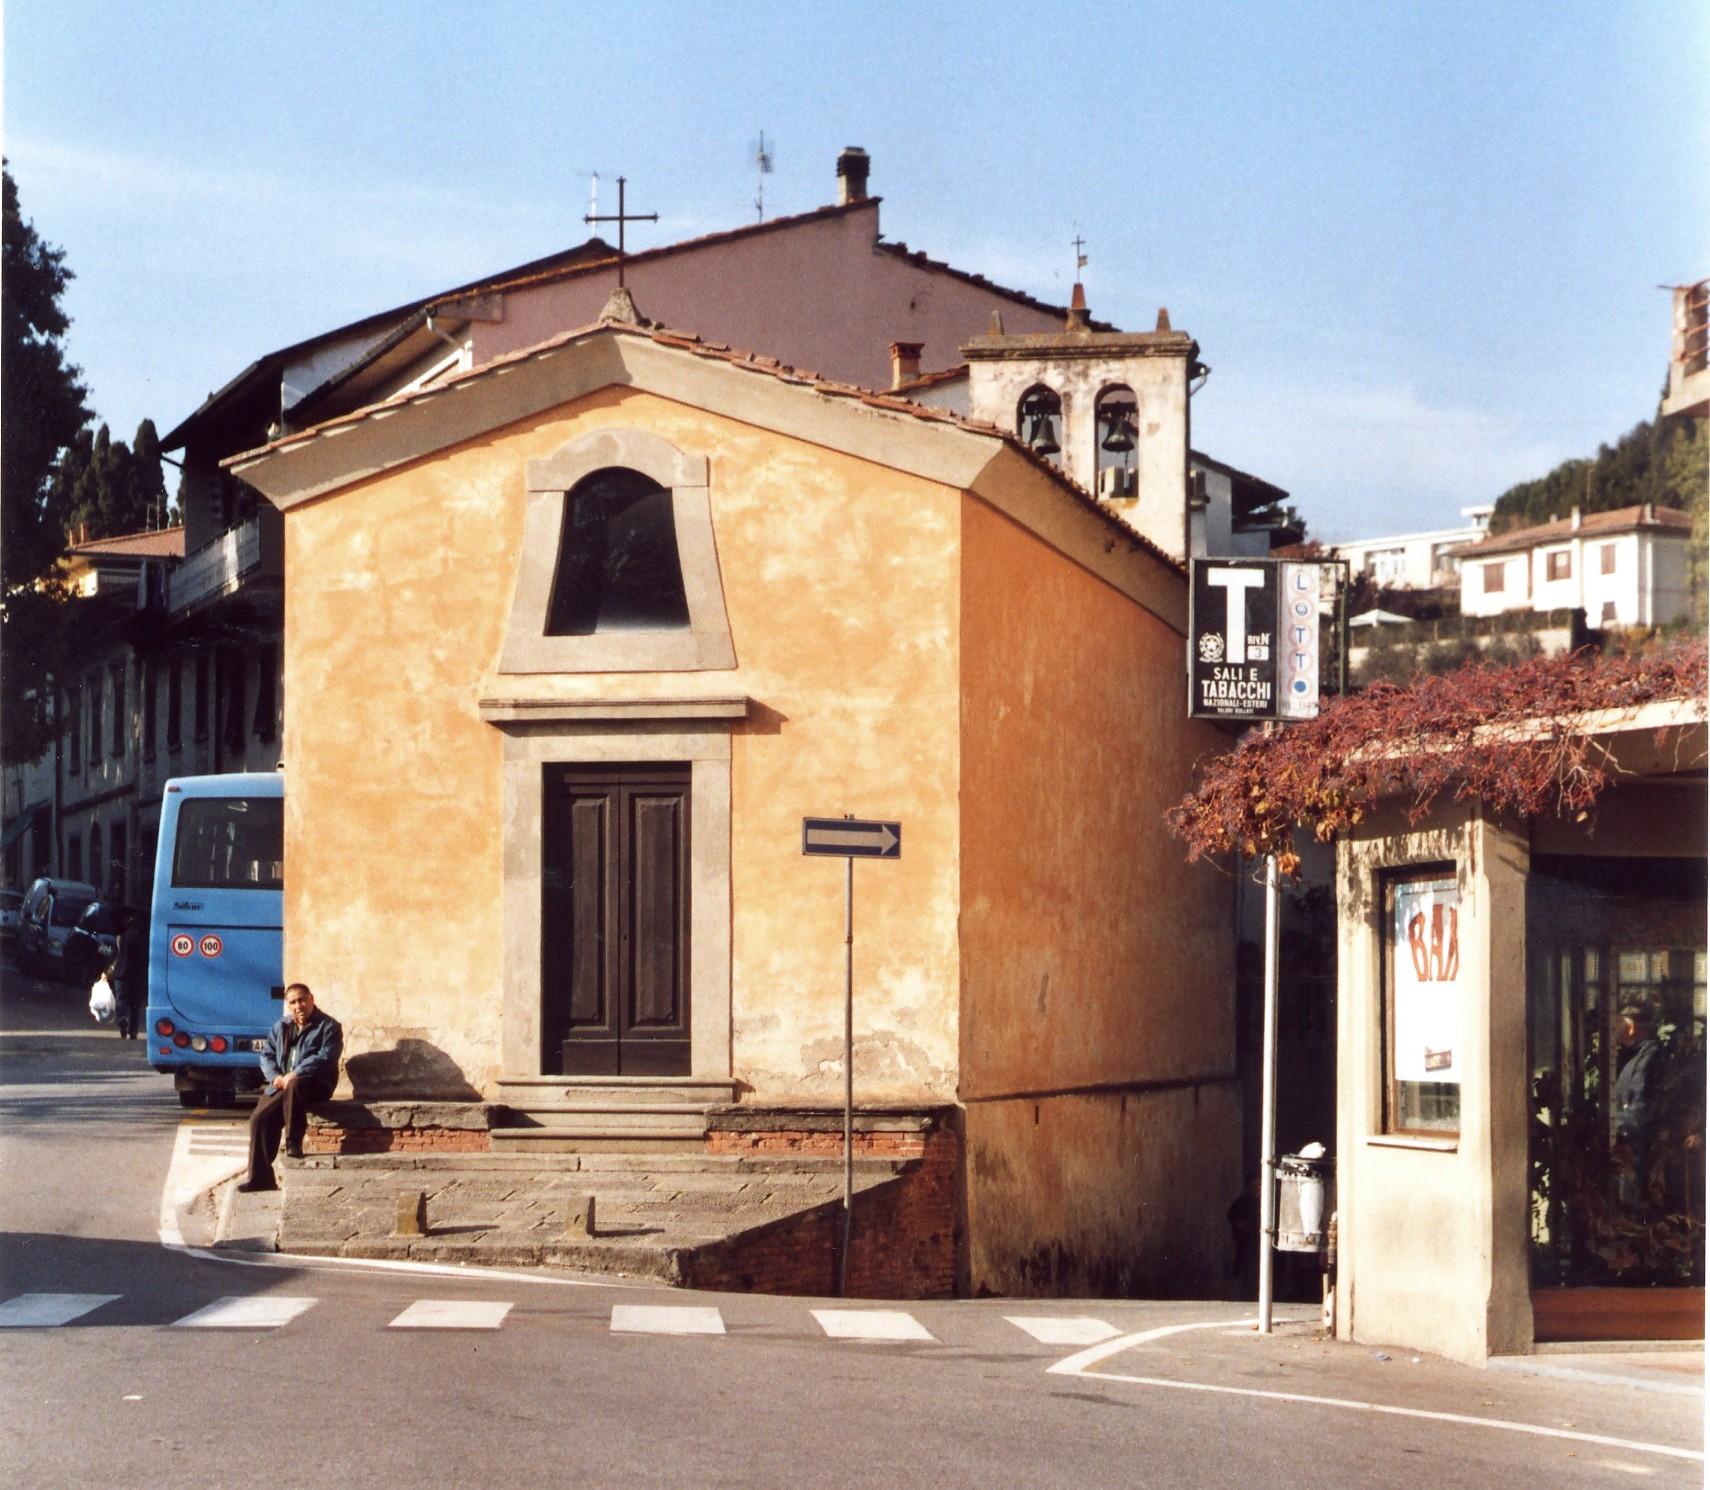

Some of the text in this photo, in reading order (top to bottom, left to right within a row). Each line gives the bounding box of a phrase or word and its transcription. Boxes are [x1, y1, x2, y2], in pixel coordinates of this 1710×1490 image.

[1207, 567, 1265, 664] T
[1213, 667, 1258, 681] SALI E
[1201, 680, 1271, 700] TABACCHI
[177, 941, 189, 951] 80
[204, 942, 218, 951] 100
